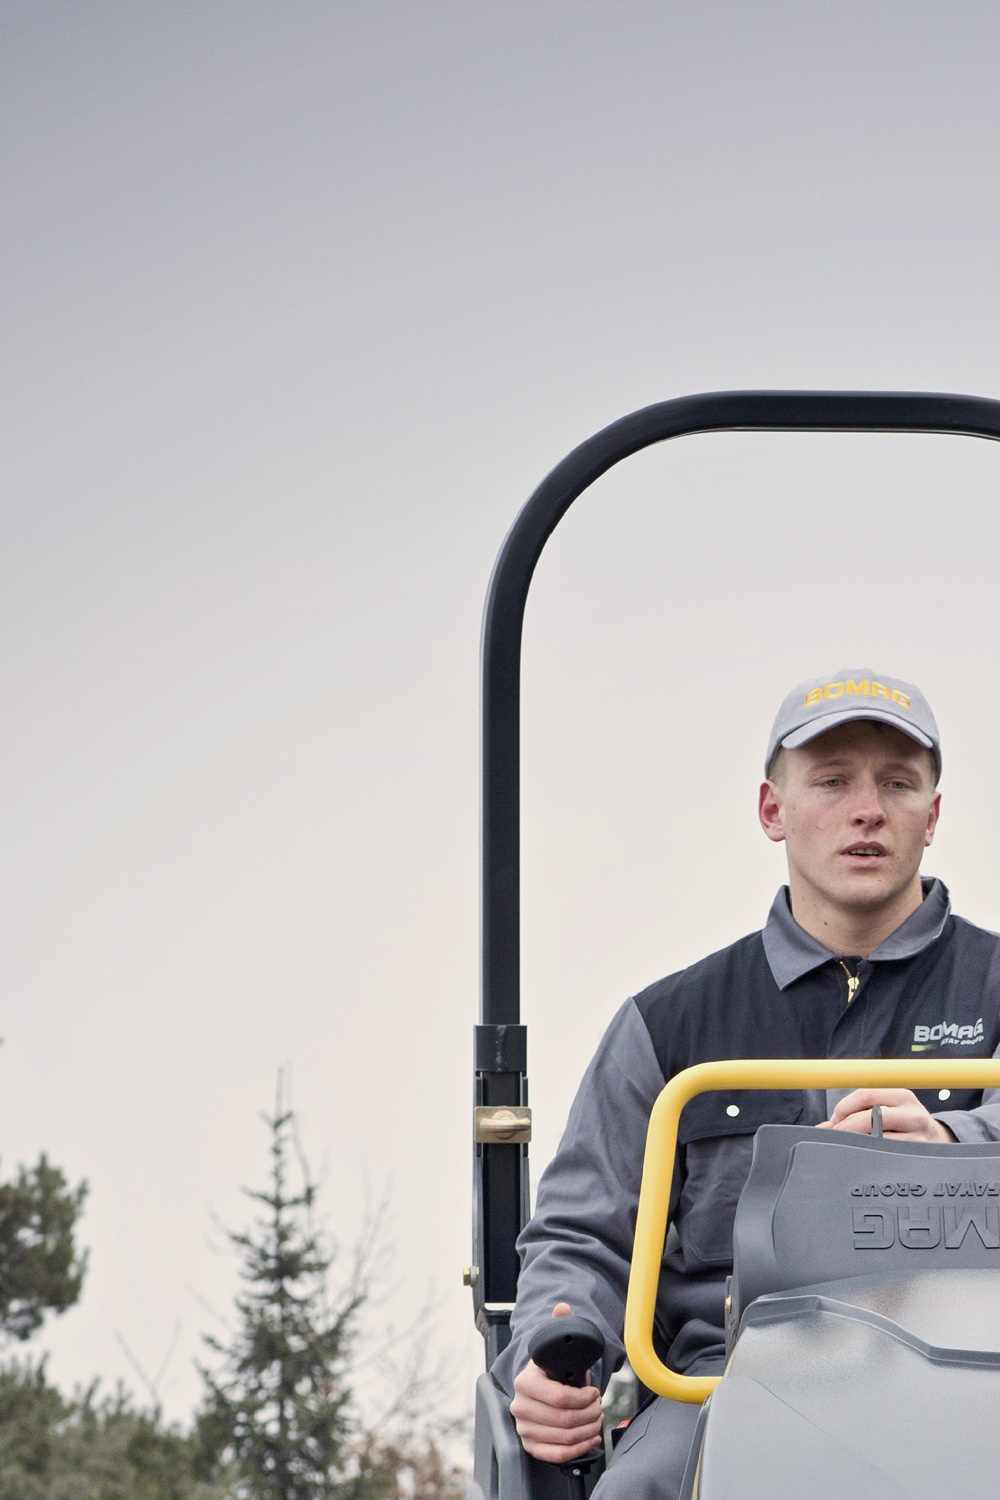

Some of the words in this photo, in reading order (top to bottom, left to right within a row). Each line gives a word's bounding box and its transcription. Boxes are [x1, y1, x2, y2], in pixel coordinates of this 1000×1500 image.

[913, 1018, 984, 1042] BOMAG
[850, 1182, 927, 1197] GROUP
[933, 1182, 1000, 1197] FAYAT
